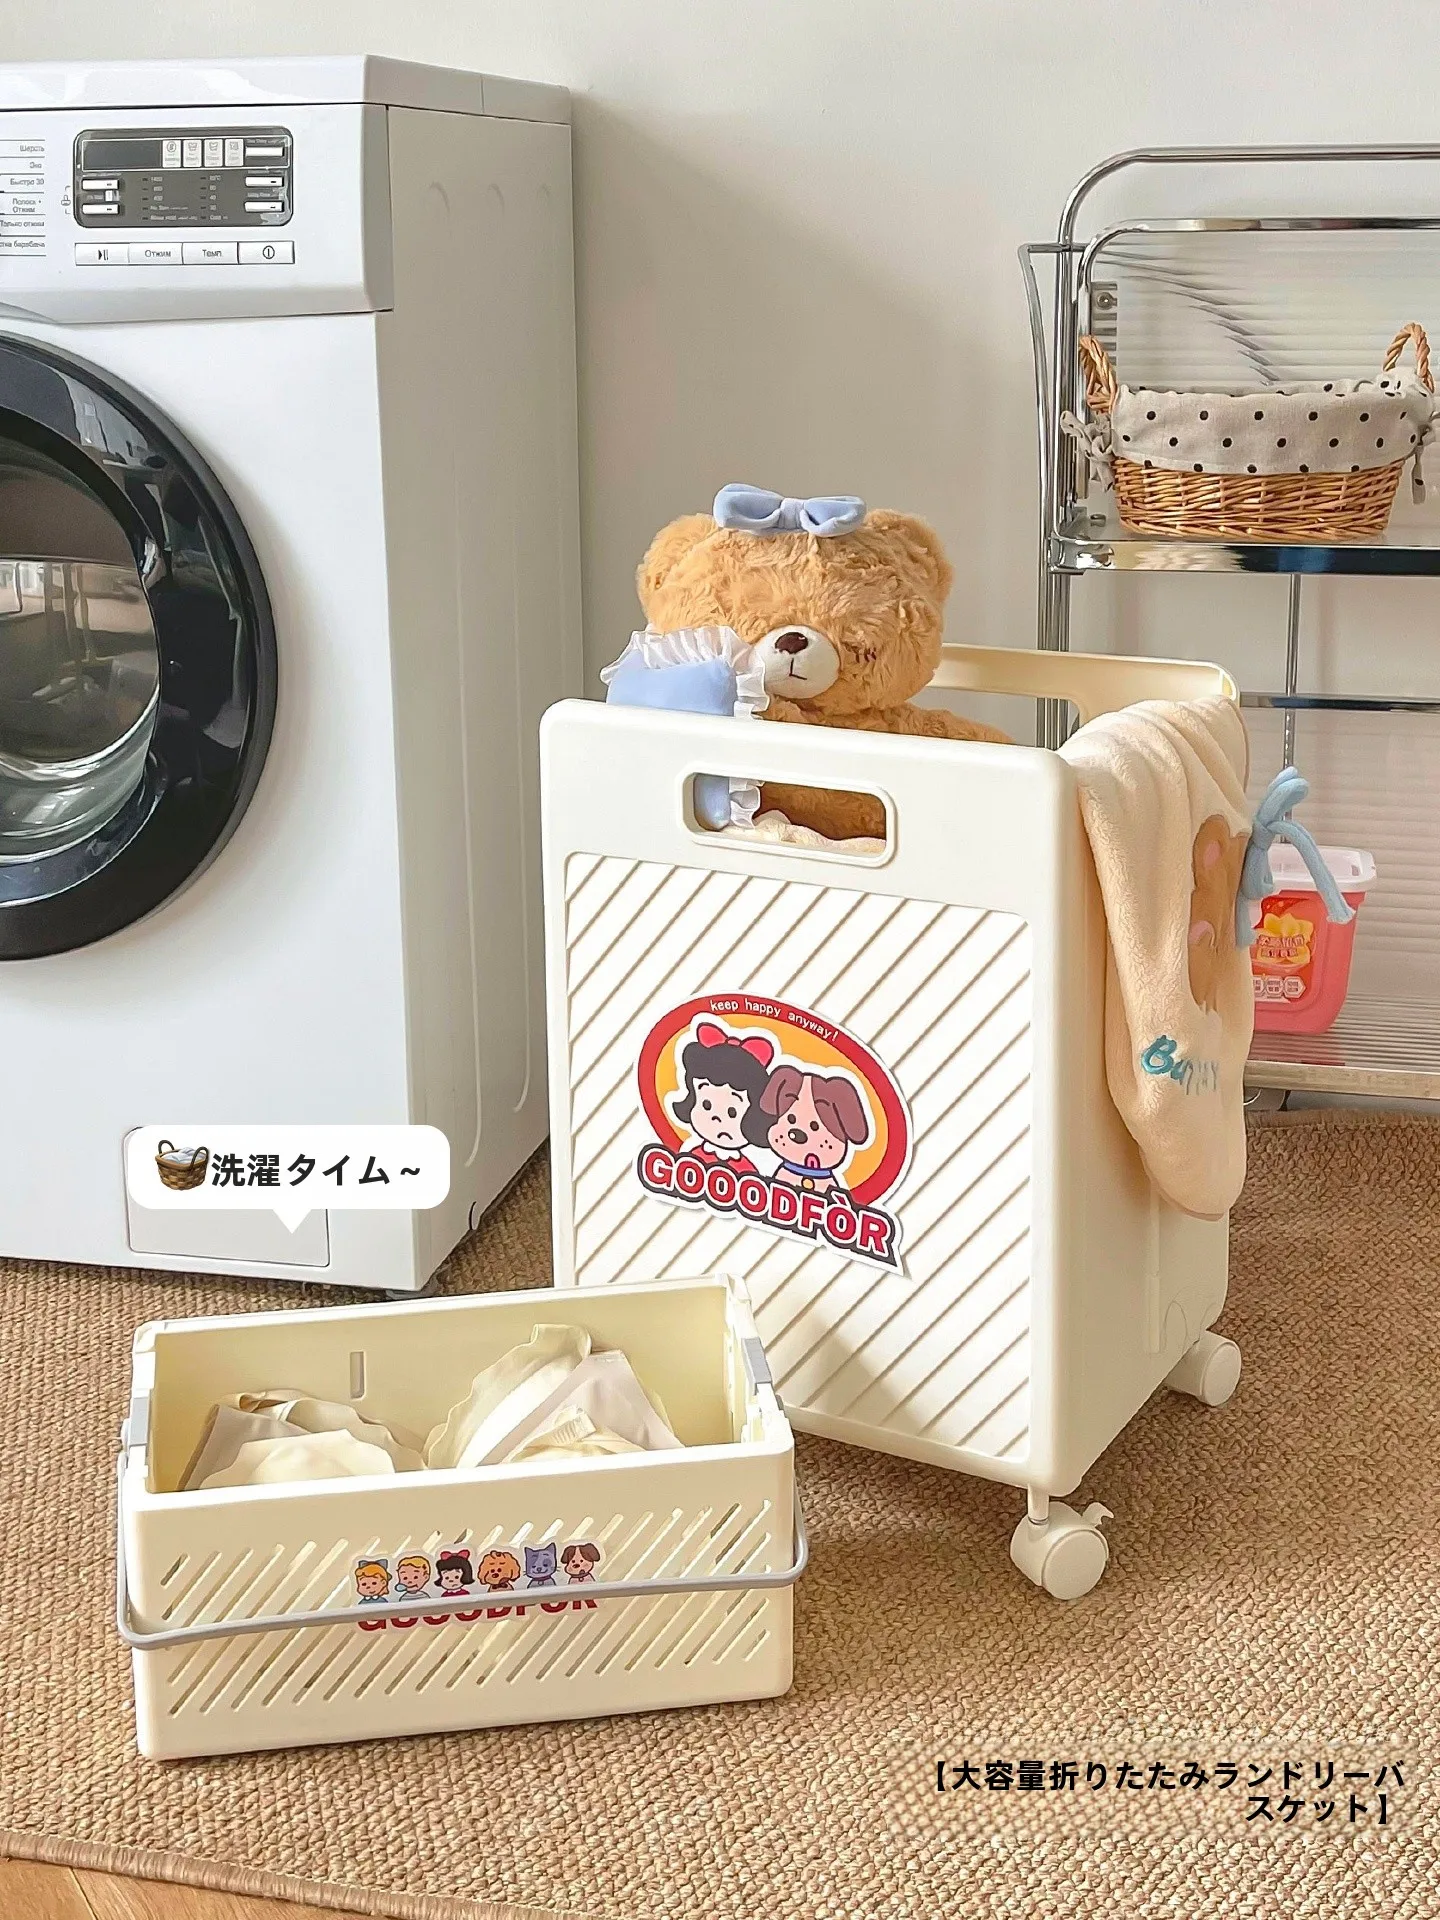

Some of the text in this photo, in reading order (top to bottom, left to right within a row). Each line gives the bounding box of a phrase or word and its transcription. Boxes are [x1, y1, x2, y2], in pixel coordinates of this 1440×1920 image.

[144, 249, 172, 258] Отжим
[202, 249, 223, 258] Темп
[709, 998, 839, 1042] keep happy anyway!
